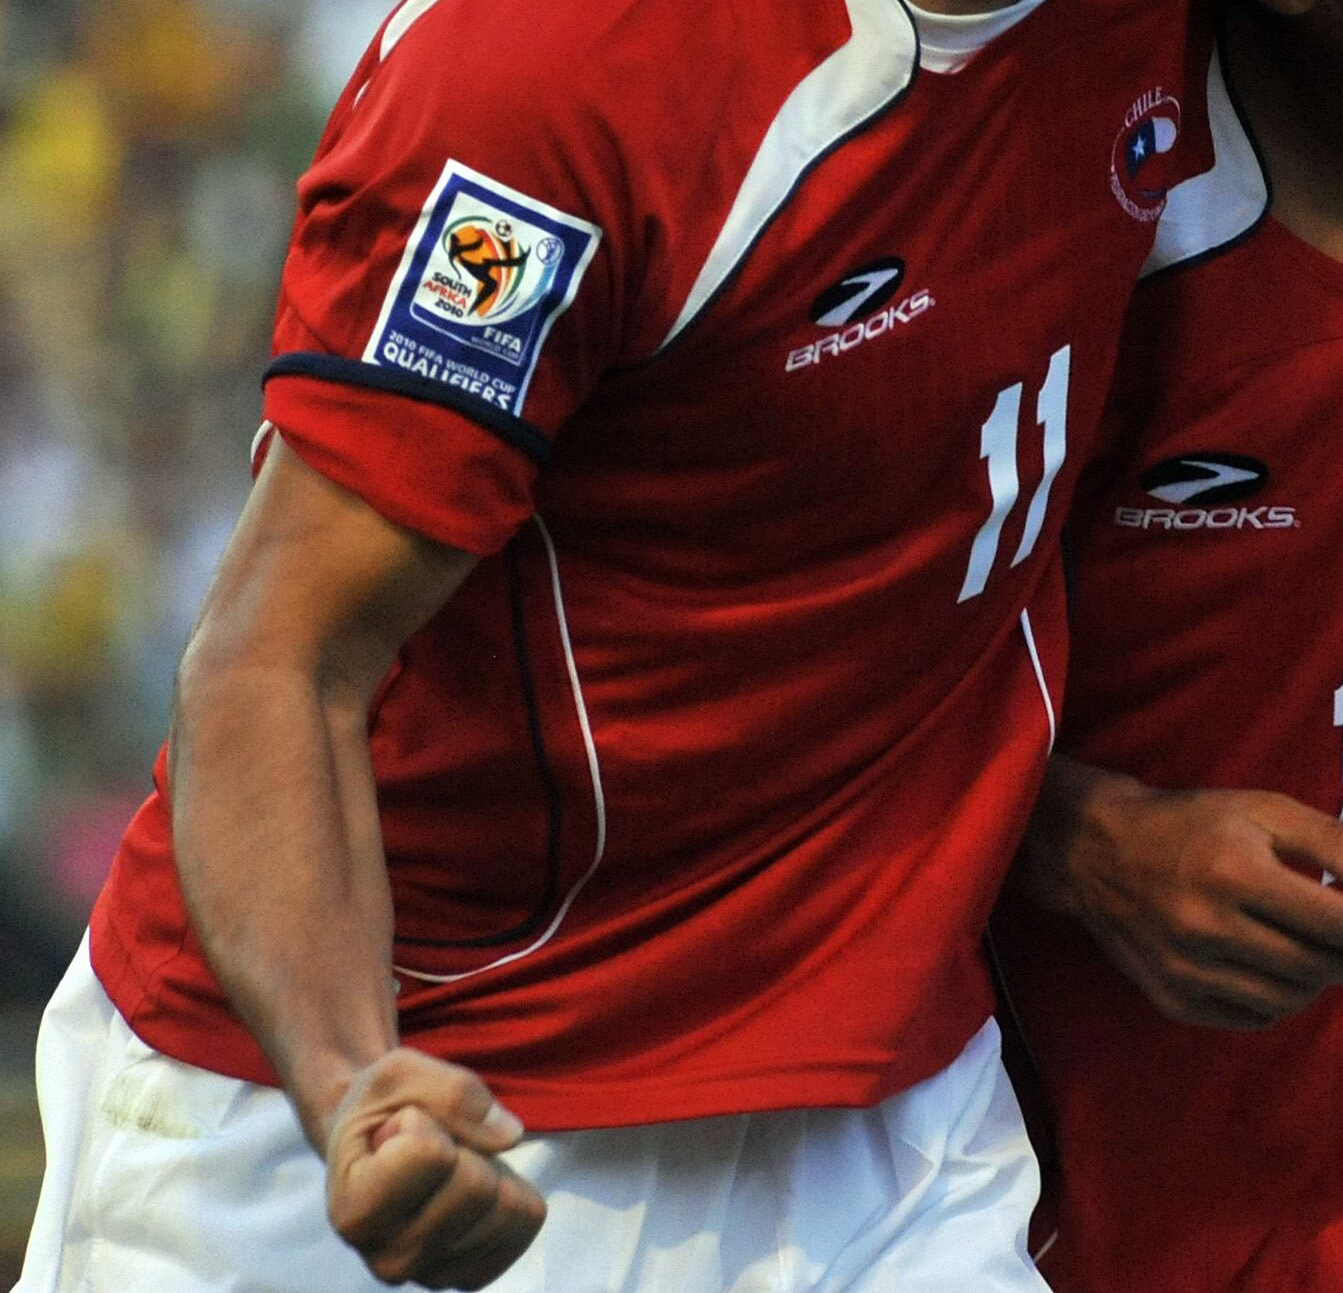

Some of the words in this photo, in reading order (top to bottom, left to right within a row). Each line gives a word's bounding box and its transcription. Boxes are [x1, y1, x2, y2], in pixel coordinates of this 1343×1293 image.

[1125, 87, 1162, 128] CHILE
[423, 281, 466, 308] AFRICA
[432, 271, 472, 298] SOUTH
[434, 298, 464, 318] 2010
[483, 326, 520, 353] FIFA
[784, 288, 931, 372] BROOKS
[389, 330, 416, 351] 2010
[418, 345, 443, 364] FIFA
[446, 359, 490, 383] WORLD
[491, 378, 516, 394] CUP
[956, 344, 1070, 604] 11
[1115, 506, 1297, 530] BROOKS
